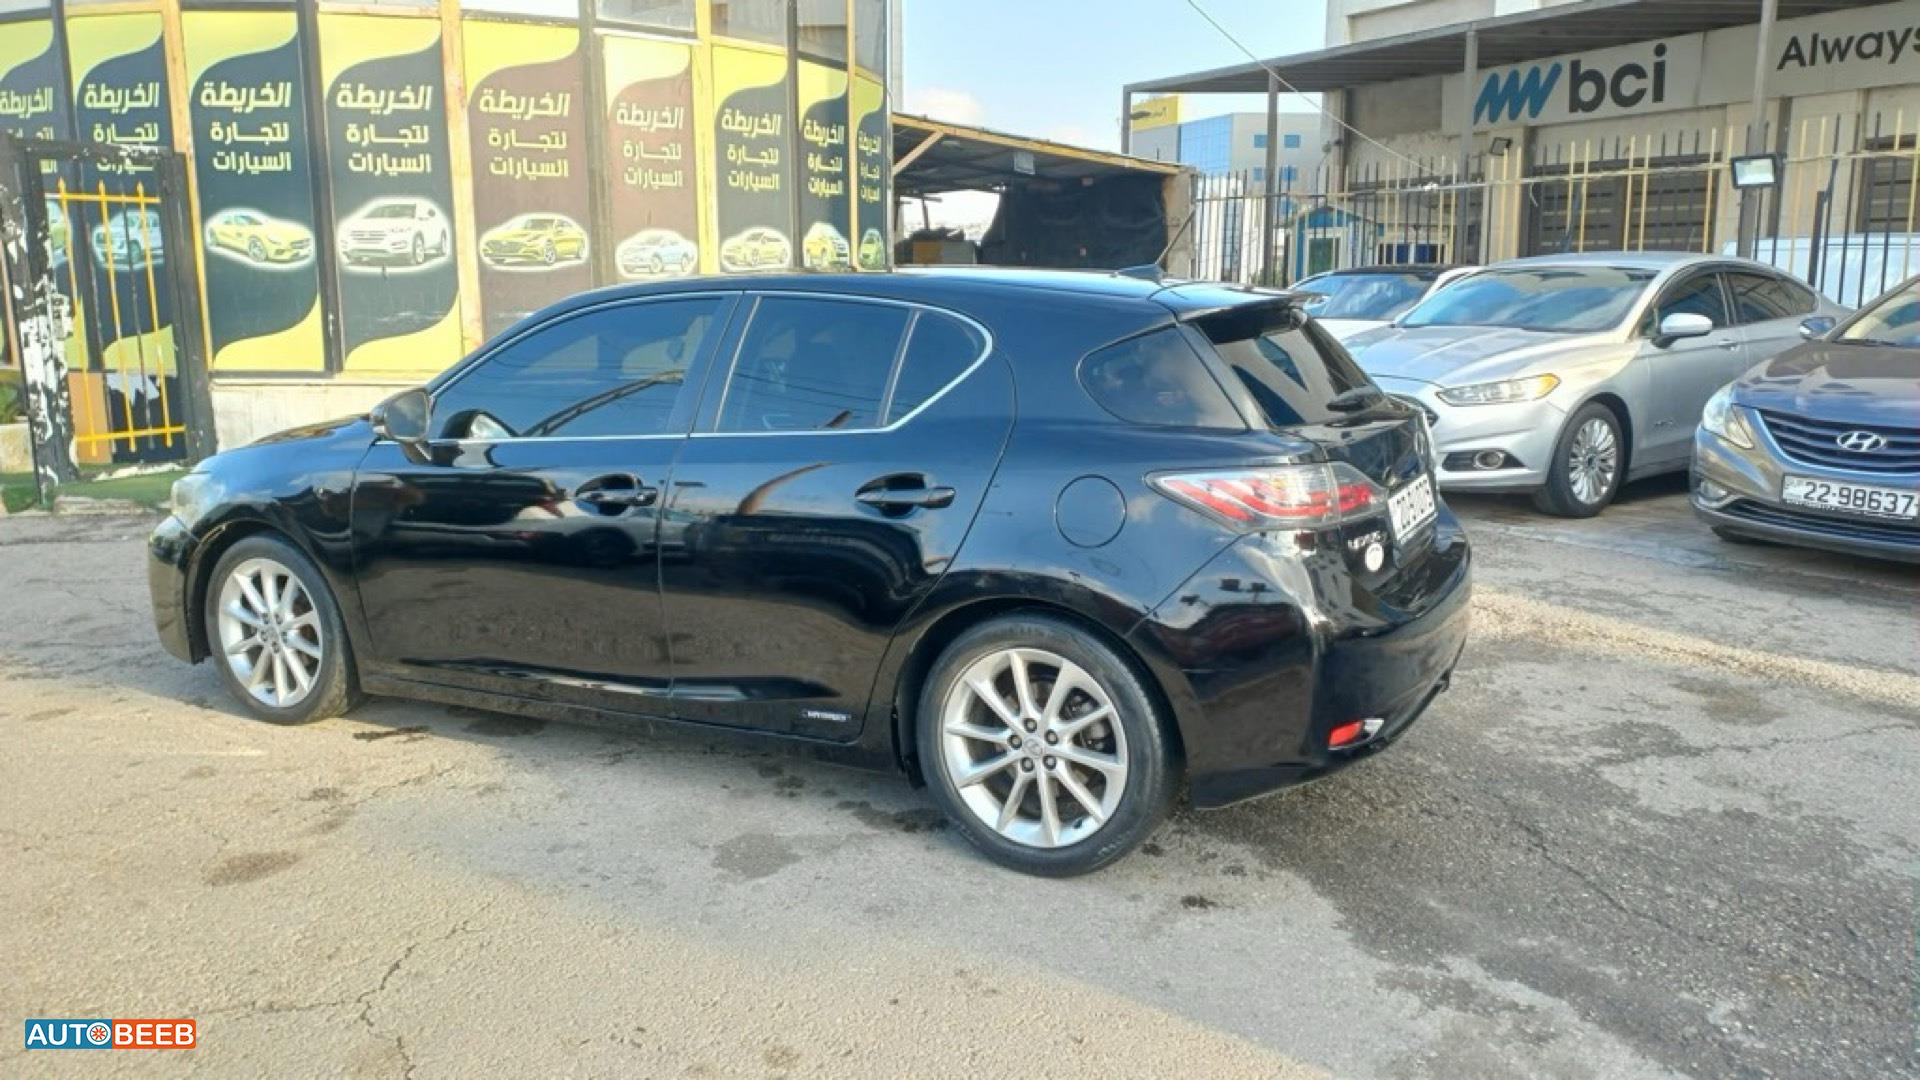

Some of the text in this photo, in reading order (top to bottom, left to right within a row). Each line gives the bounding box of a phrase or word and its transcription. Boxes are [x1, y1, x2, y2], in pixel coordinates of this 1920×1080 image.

[1568, 43, 1667, 113] bci
[0, 87, 53, 118] الخريطة
[84, 82, 160, 114] الخريطة
[200, 82, 292, 113] الخريطة
[335, 83, 433, 115] الخريطة
[479, 88, 571, 120] الخريطة
[616, 103, 685, 132] الخريطة
[721, 108, 782, 139] الخريطة
[93, 122, 158, 144] لتجارة
[210, 121, 289, 145] لتجارة
[346, 123, 430, 148] لتجارة
[488, 128, 567, 152] لتجارة
[803, 119, 845, 148] الخريطة
[212, 151, 292, 175] السيارات
[623, 140, 682, 163] لتجارة
[727, 144, 779, 167] لتجارة
[807, 152, 843, 172] لتجارة
[348, 153, 432, 176] السيارات
[489, 156, 569, 181] السيارات
[624, 167, 683, 190] السيارات
[728, 171, 780, 192] السيارات
[808, 176, 843, 199] السيارات
[1804, 481, 1914, 514] 22-98637
